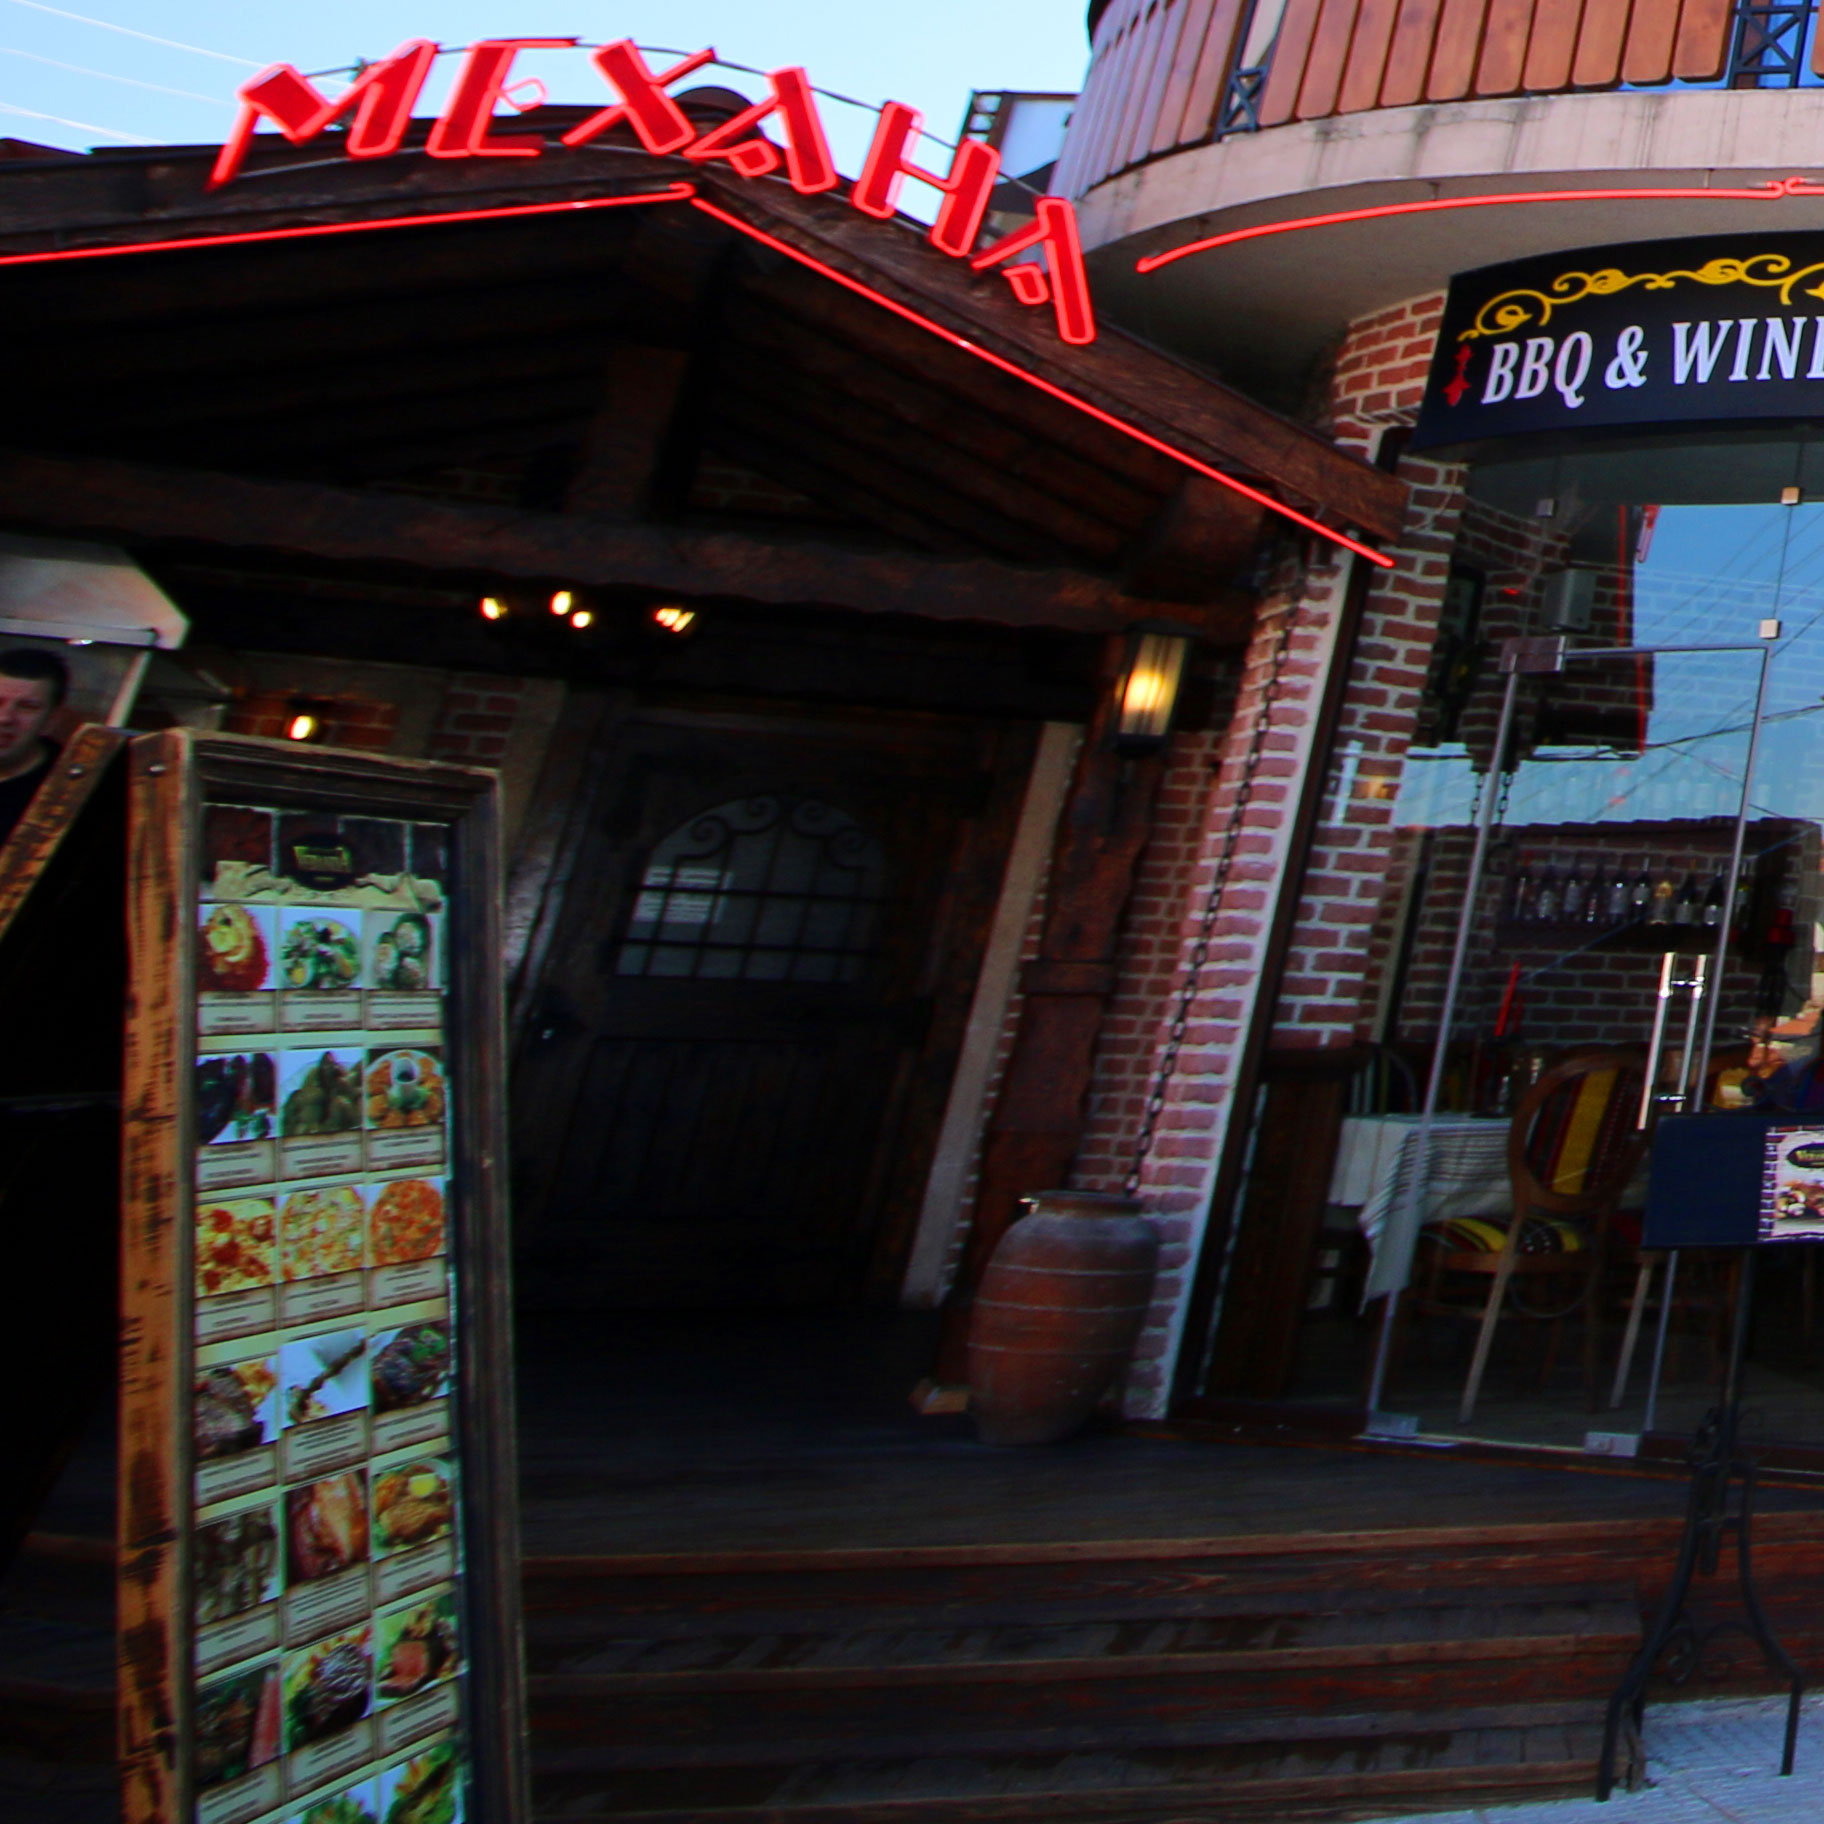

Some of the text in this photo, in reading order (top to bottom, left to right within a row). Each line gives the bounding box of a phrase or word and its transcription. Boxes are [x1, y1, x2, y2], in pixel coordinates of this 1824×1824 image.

[204, 38, 1097, 344] МЕХАНА
[1481, 330, 1592, 409] BBQ
[1604, 325, 1649, 390] &
